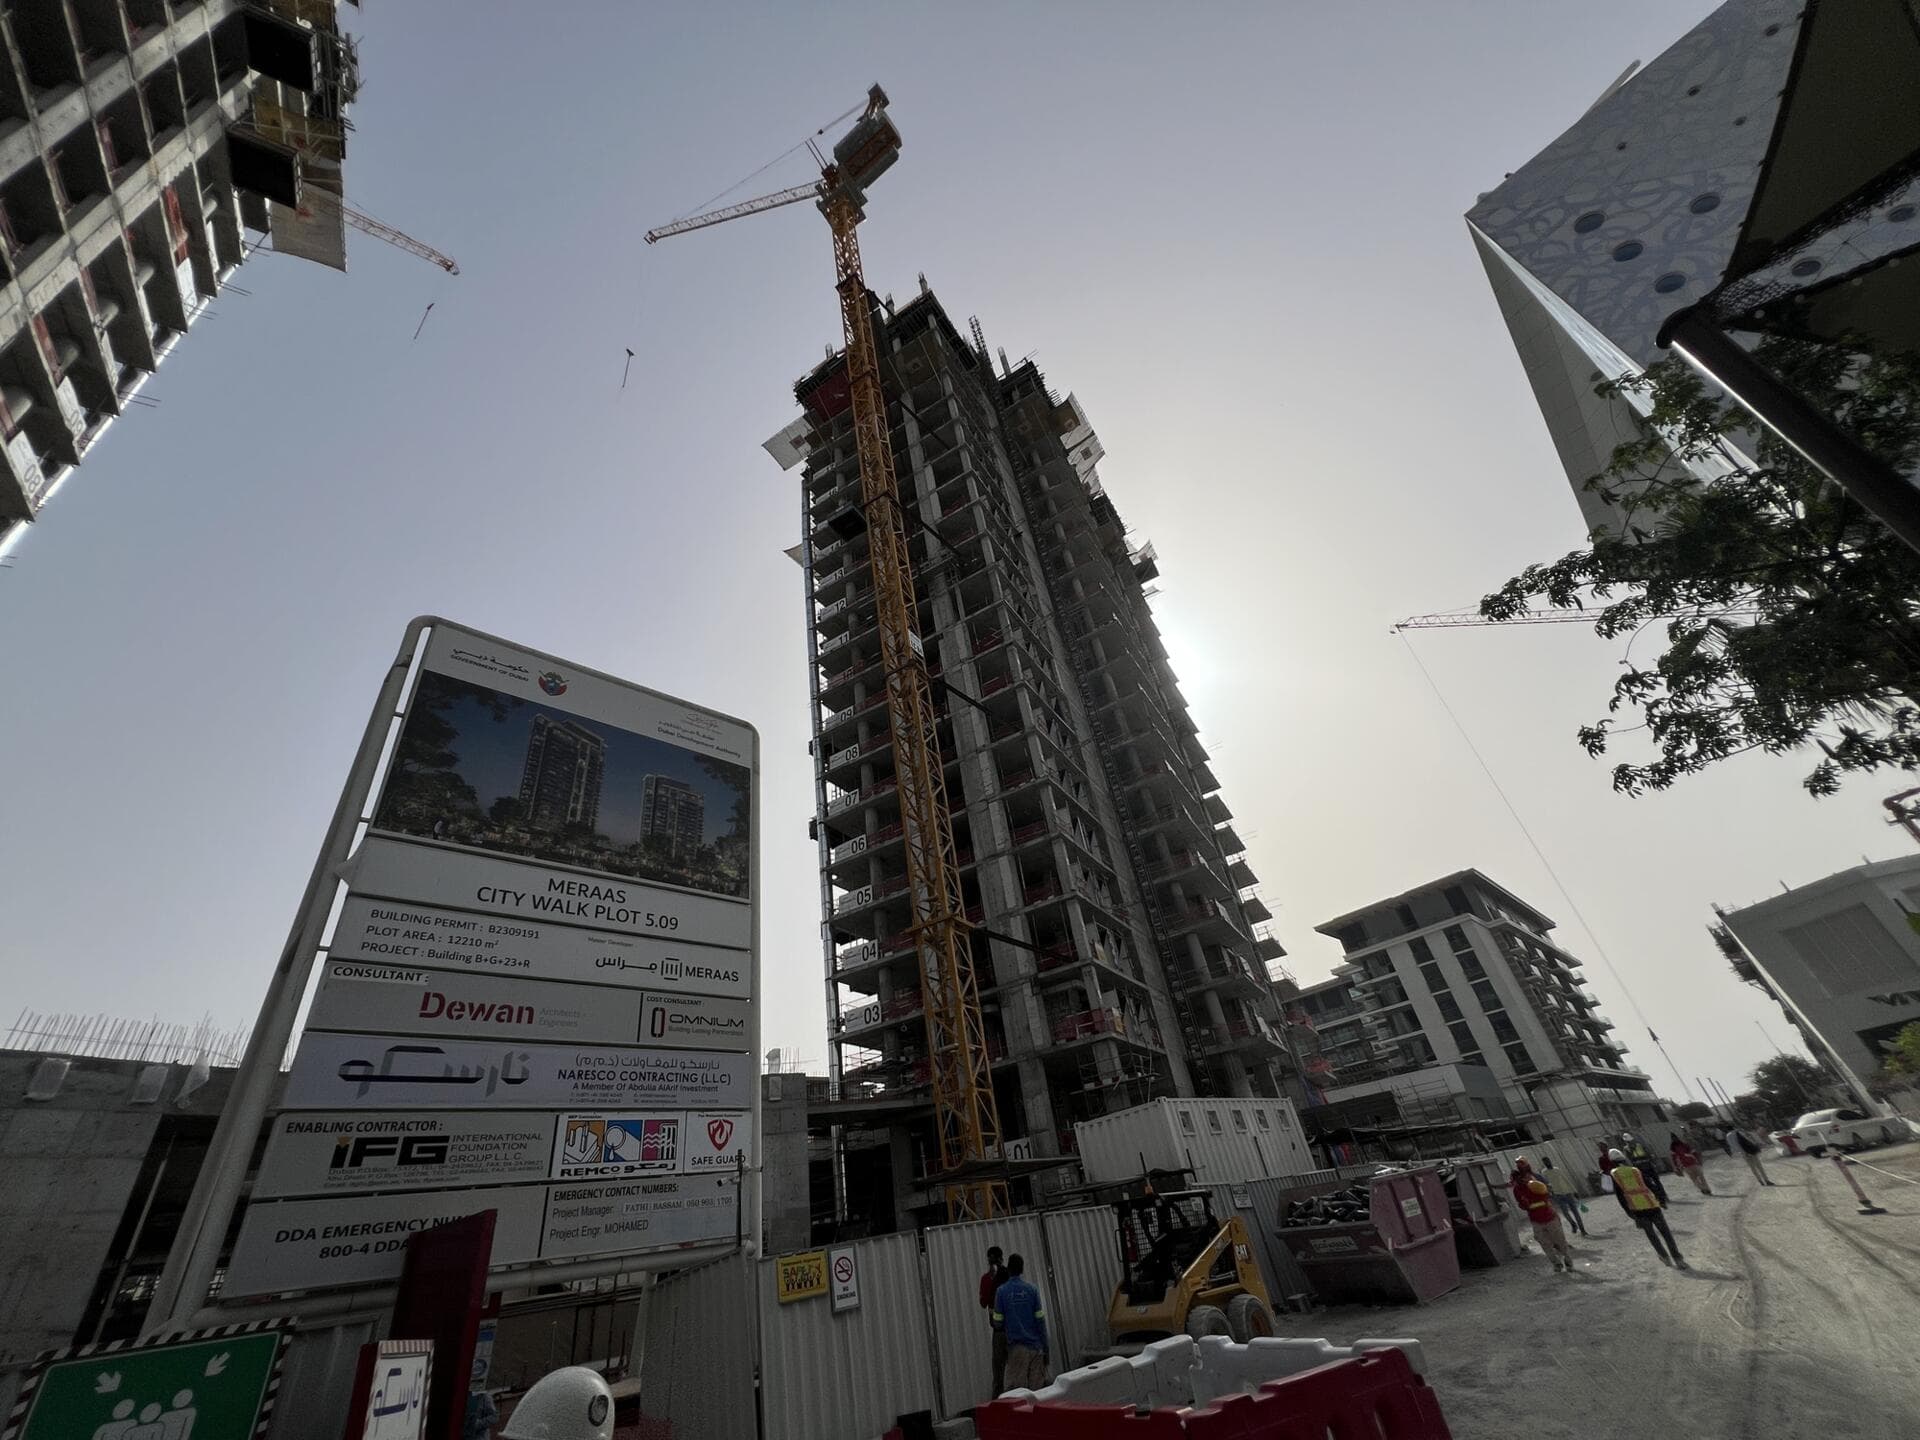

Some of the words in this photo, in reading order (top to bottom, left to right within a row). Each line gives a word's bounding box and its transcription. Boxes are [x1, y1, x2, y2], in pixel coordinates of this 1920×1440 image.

[24, 463, 40, 493] 08
[836, 598, 847, 611] 12
[840, 631, 850, 644] 11
[841, 708, 853, 721] 09
[845, 746, 858, 761] 08
[845, 791, 858, 807] 07
[851, 838, 865, 854] 06
[547, 877, 626, 904] MERAAS
[856, 887, 871, 906] 05
[477, 885, 526, 908] CITY
[531, 893, 588, 918] WALK
[594, 905, 640, 925] PLOT
[646, 911, 679, 931] 5.09
[370, 908, 432, 928] BUILDING
[434, 916, 478, 932] PERMIT
[488, 924, 540, 940] B2309191
[365, 924, 400, 938] PLOT
[402, 927, 436, 942] AREA
[447, 934, 482, 949] 12210
[360, 941, 419, 957] PROJECT
[427, 948, 472, 965] Building
[475, 953, 531, 969] B+G+23+R
[862, 942, 876, 962] 04
[333, 966, 422, 982] CONSULTANT
[685, 965, 739, 982] MERAAS
[418, 991, 535, 1025] Dewan
[864, 1005, 880, 1025] 03
[669, 1013, 744, 1028] OMNIUM
[557, 1069, 616, 1081] NARESCO
[620, 1070, 698, 1083] CONTRACTING
[701, 1072, 731, 1086] (LLC)
[581, 1083, 614, 1091] Member
[286, 1121, 355, 1134] ENABLING
[355, 1120, 437, 1133] CONTRACTOR
[451, 1133, 543, 1142] INTERNATIONAL
[450, 1142, 528, 1152] FOUNDATION
[691, 1155, 714, 1166] SAFE
[559, 1165, 620, 1178] REMCO
[553, 1188, 604, 1202] EMERGENCY
[605, 1186, 641, 1198] CONTACT
[642, 1183, 680, 1194] NUMBERS:
[552, 1206, 580, 1218] Project
[275, 1228, 317, 1243] DDA
[321, 1217, 429, 1239] EMERGENCY
[550, 1227, 580, 1240] Project
[604, 1219, 649, 1234] MOHAMED
[319, 1243, 370, 1259] 800-4
[374, 1239, 410, 1254] DDA
